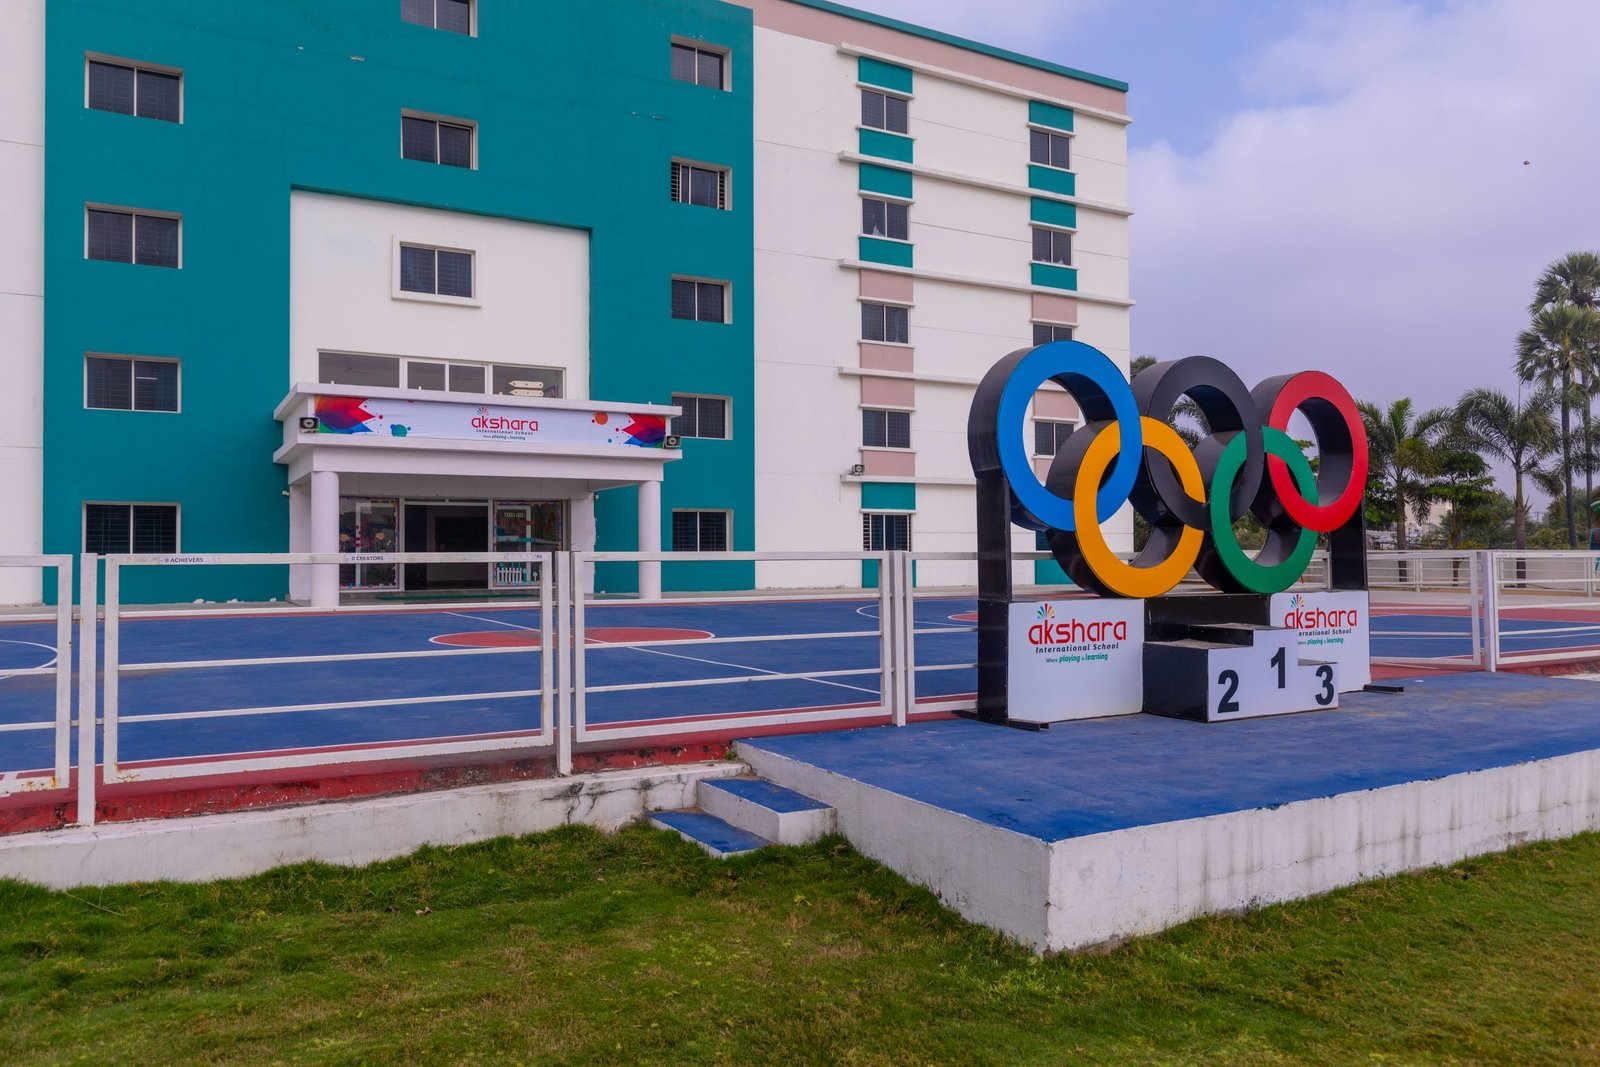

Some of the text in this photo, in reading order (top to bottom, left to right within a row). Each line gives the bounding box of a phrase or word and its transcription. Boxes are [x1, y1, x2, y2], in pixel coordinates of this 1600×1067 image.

[471, 416, 539, 432] akshara
[1284, 607, 1358, 629] akshara
[1028, 618, 1127, 645] akshara
[1298, 629, 1331, 637] ernational
[1035, 642, 1119, 654] International School
[1058, 654, 1080, 664] playing
[1085, 653, 1109, 662] learning
[1270, 646, 1286, 689] 1
[1217, 669, 1240, 714] 2
[1314, 664, 1335, 706] 3
